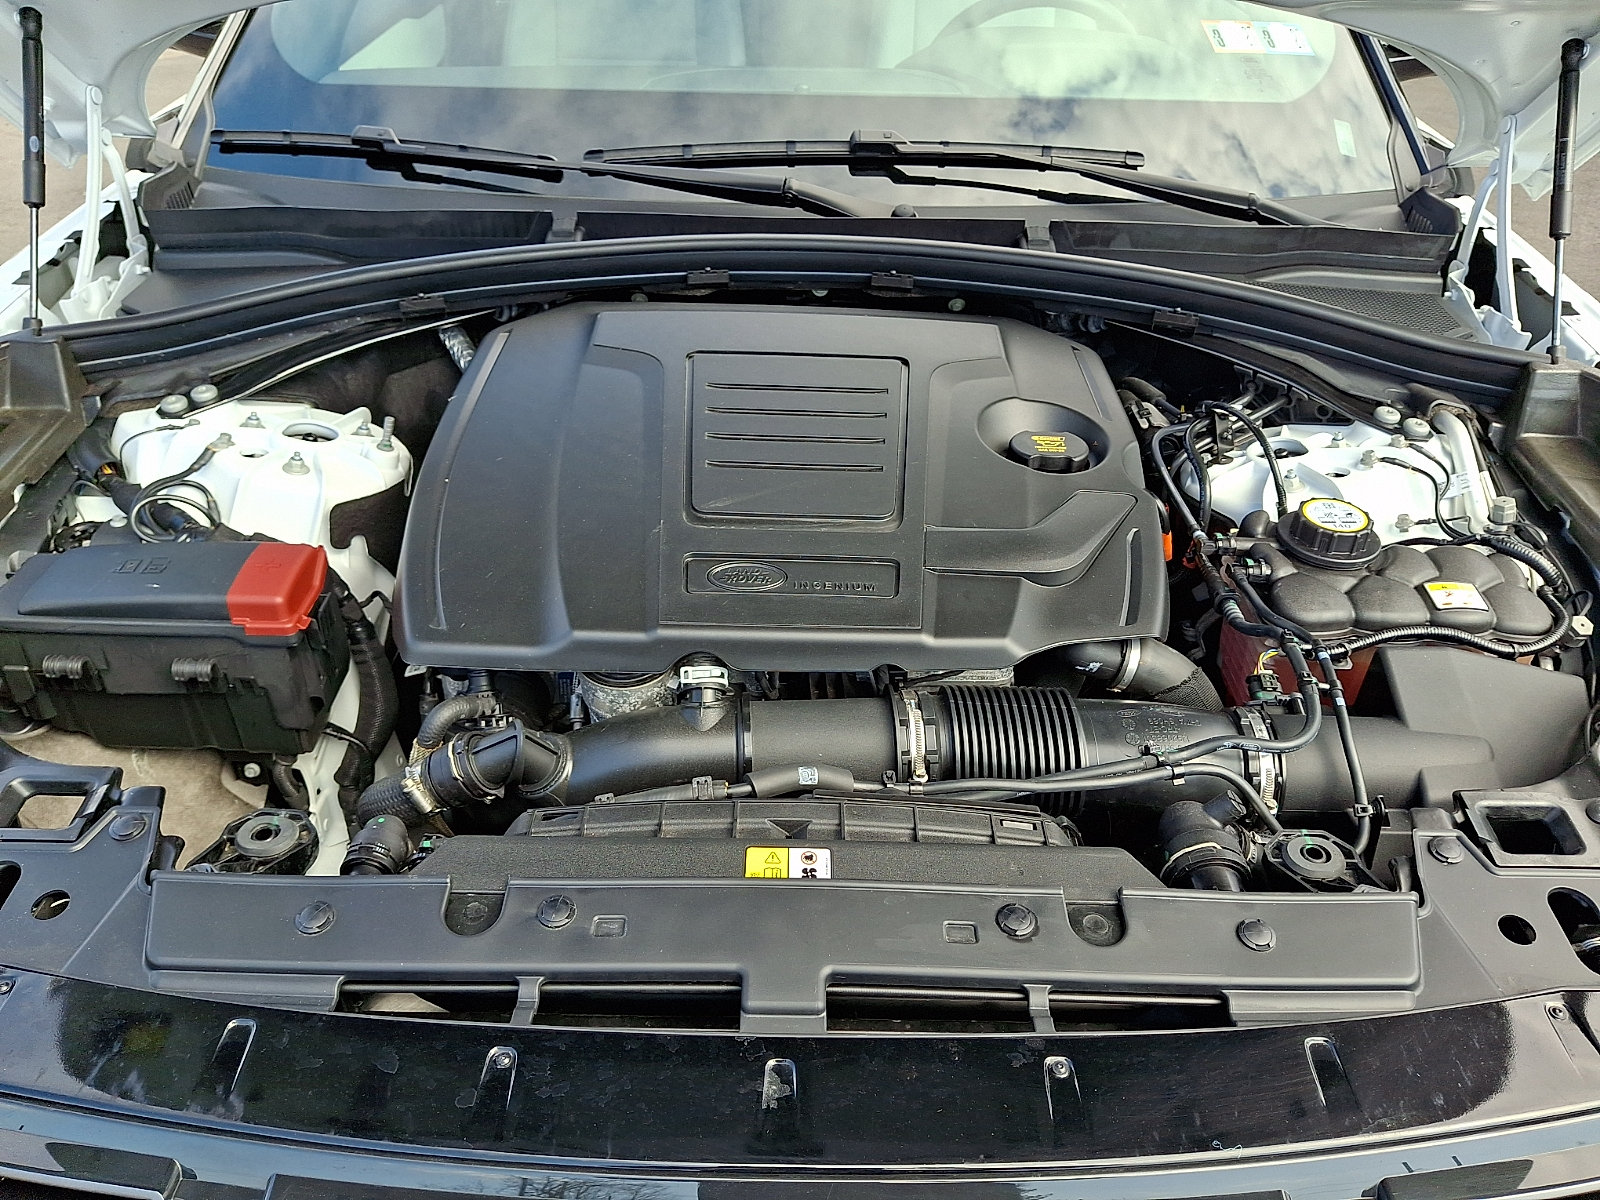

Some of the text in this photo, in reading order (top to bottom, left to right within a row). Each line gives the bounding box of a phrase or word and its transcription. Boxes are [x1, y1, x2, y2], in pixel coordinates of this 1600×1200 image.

[725, 568, 769, 577] LAND
[724, 576, 774, 585] ROVER
[793, 580, 877, 593] INGENIUM
